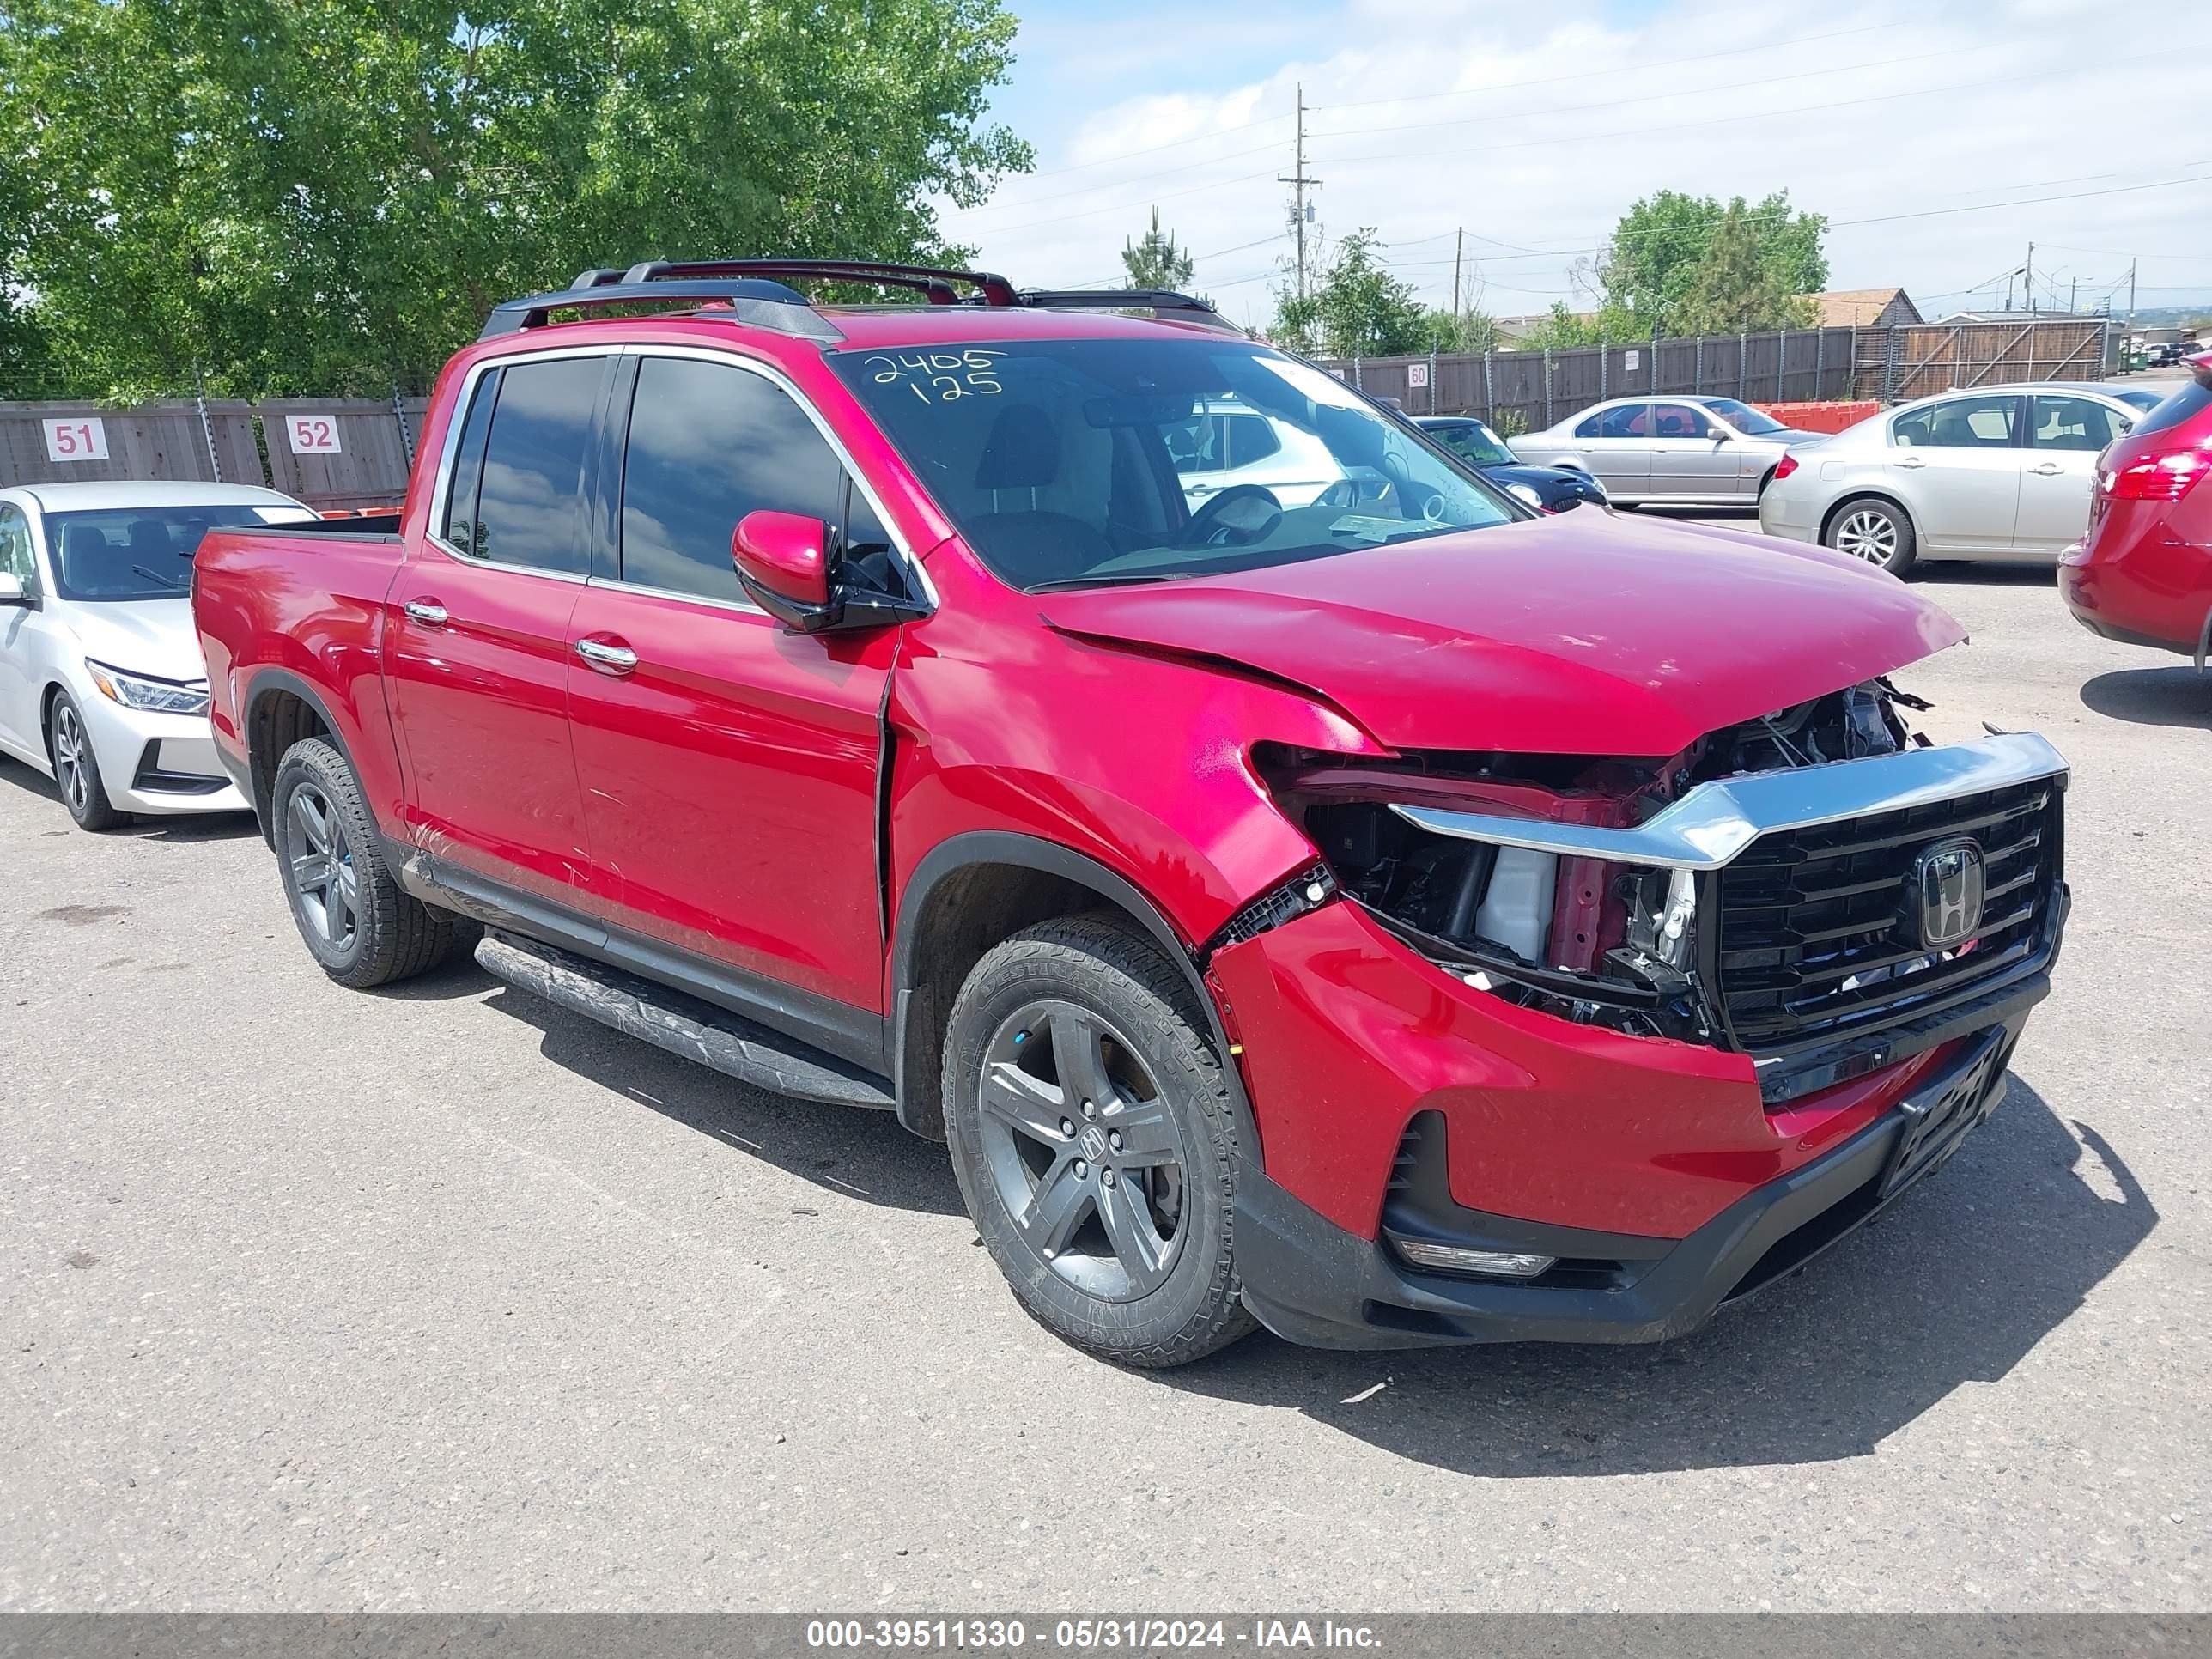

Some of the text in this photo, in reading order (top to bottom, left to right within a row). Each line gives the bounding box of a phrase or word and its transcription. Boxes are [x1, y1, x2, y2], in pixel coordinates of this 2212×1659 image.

[864, 349, 1008, 383] 2405
[1412, 368, 1425, 383] 60
[910, 371, 1003, 404] 125
[56, 423, 94, 454] 51
[296, 421, 333, 447] 52
